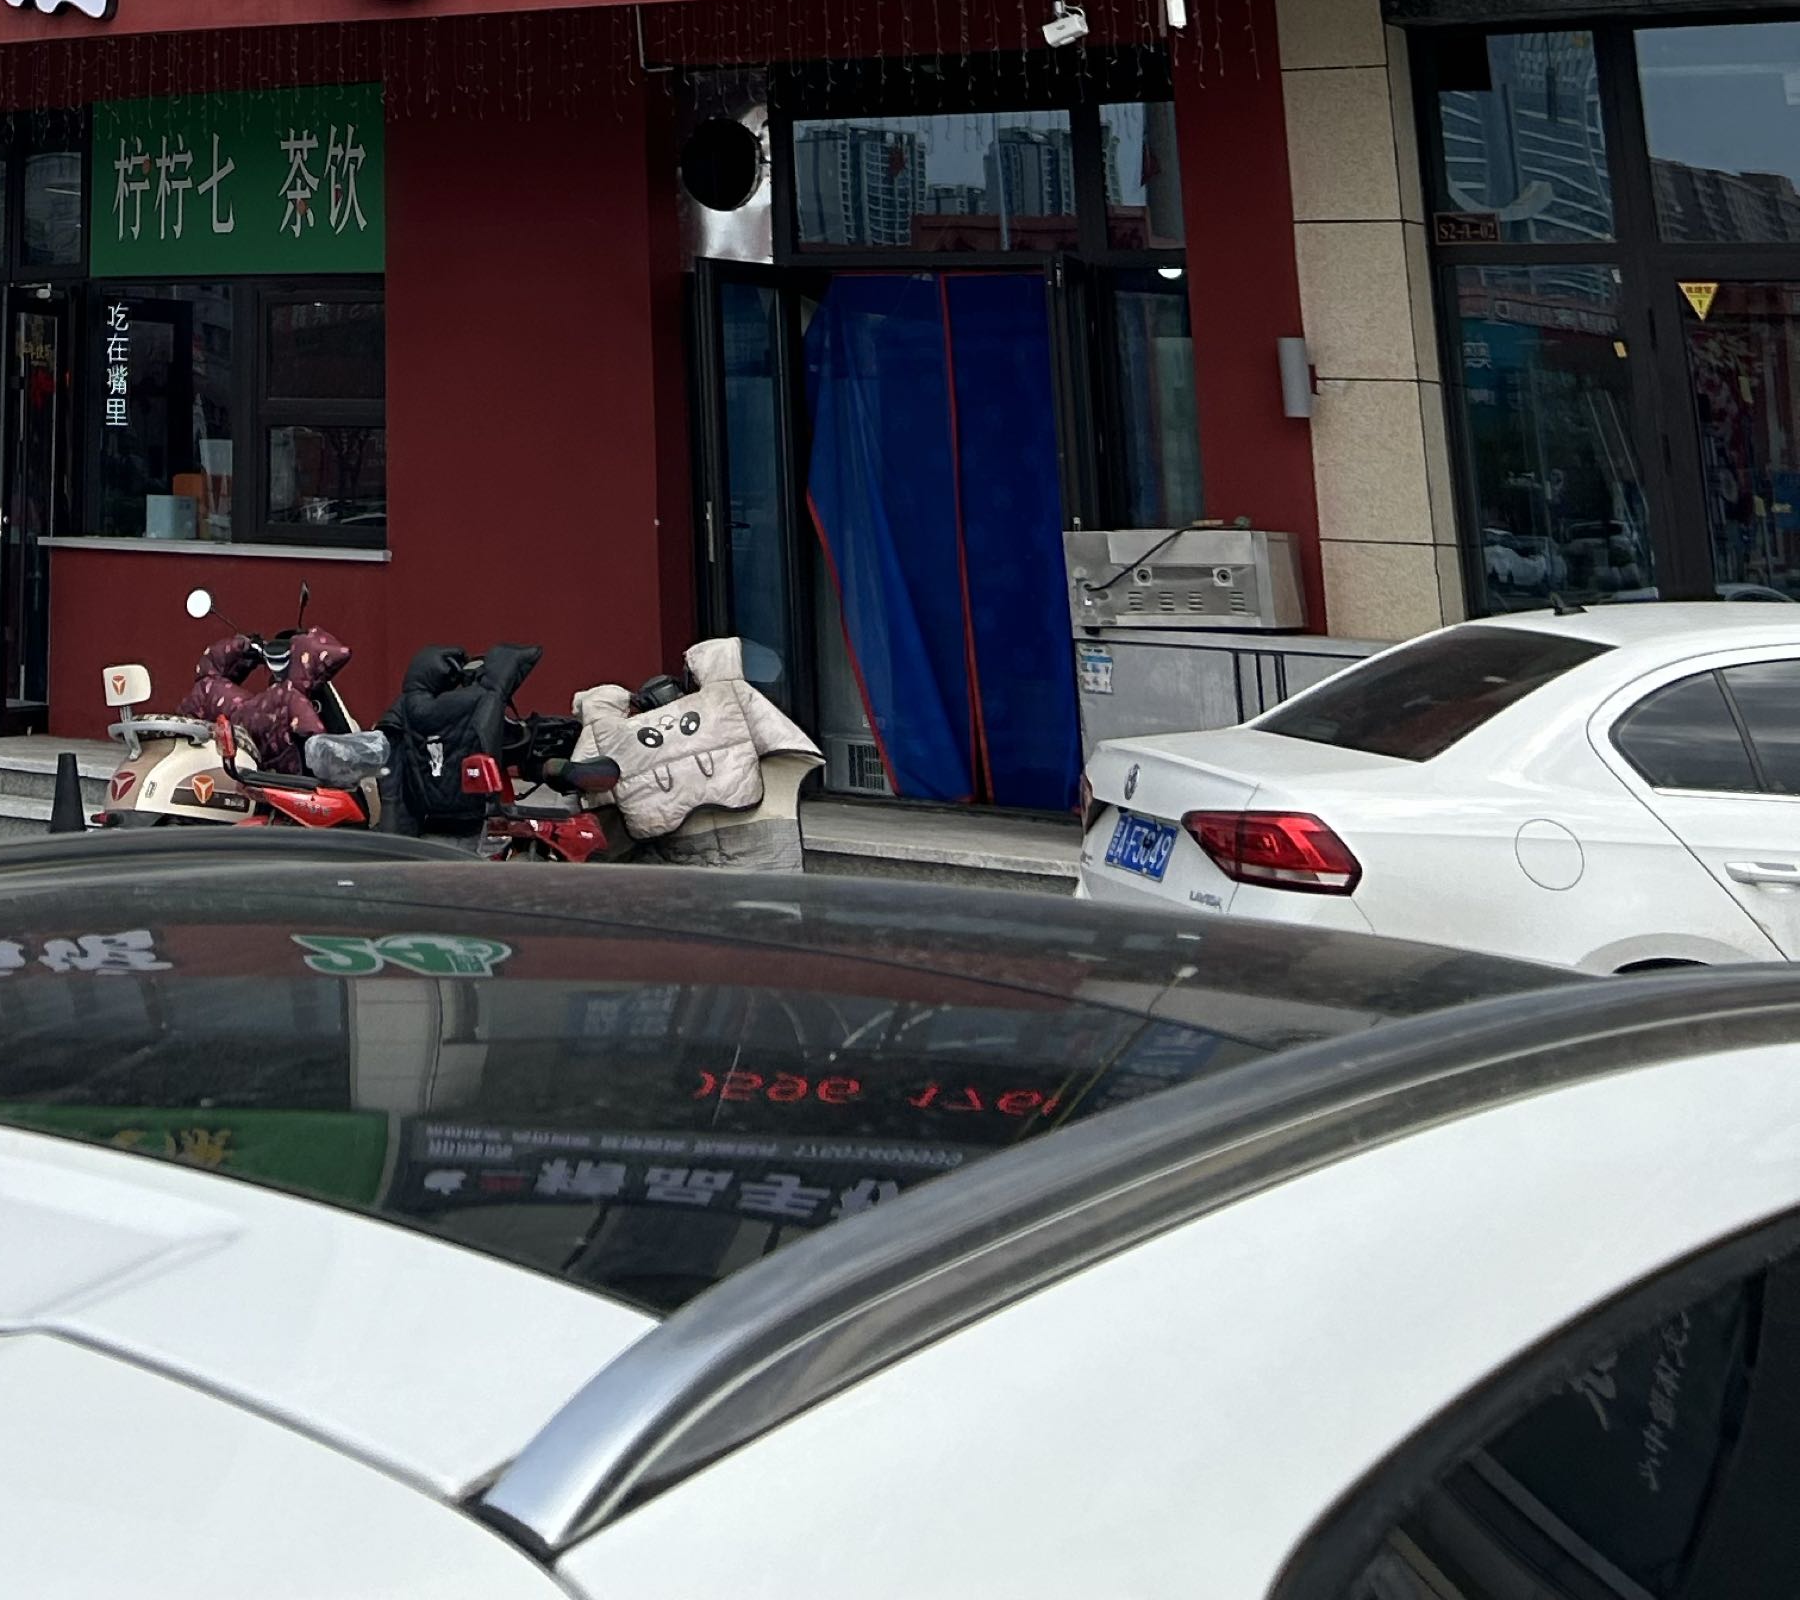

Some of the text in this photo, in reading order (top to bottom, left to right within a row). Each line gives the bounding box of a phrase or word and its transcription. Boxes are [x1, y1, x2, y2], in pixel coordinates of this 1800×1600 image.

[112, 123, 368, 241] 柠柠七 茶饮
[105, 302, 130, 427] 吃在嘴里
